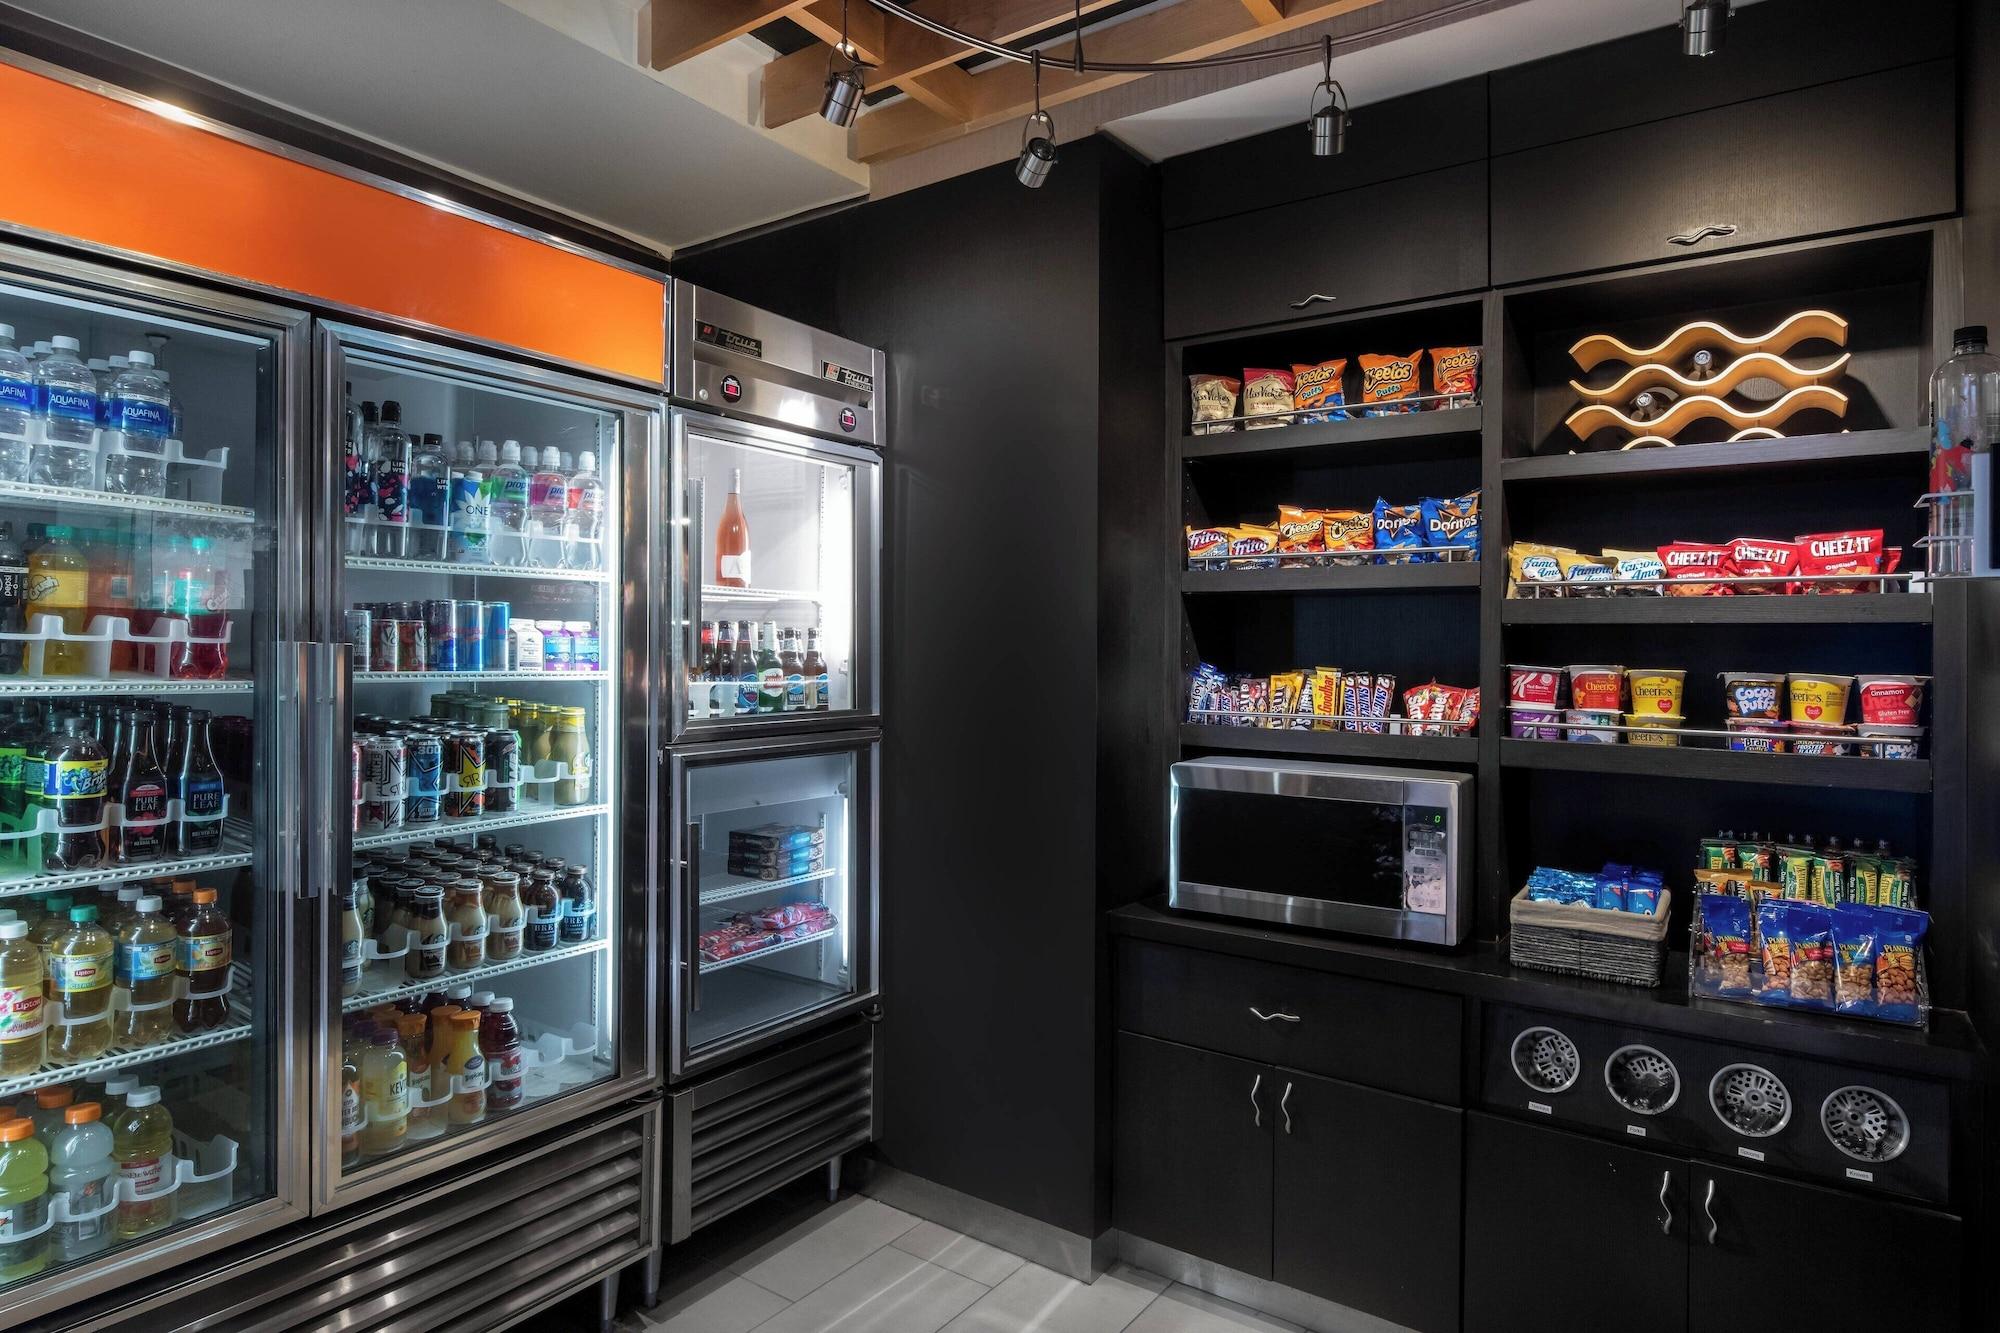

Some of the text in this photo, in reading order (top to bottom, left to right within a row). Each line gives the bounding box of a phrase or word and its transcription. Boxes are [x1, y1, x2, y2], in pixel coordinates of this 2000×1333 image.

[1302, 386, 1322, 399] Puffs
[1377, 385, 1400, 397] Puffs
[50, 394, 90, 409] AQUAFINA
[122, 406, 161, 421] AQUAFINA
[466, 505, 488, 516] ONE
[1430, 514, 1477, 532] Doritos
[1567, 565, 1613, 580] Famous
[4, 574, 12, 597] pepsi
[1871, 689, 1905, 697] Cinnamon
[135, 796, 158, 805] PURE
[193, 792, 220, 801] PURE
[135, 803, 158, 812] LEAF
[193, 800, 219, 810] LEAF
[1883, 944, 1914, 952] PLANTER
[16, 998, 41, 1011] Lipton
